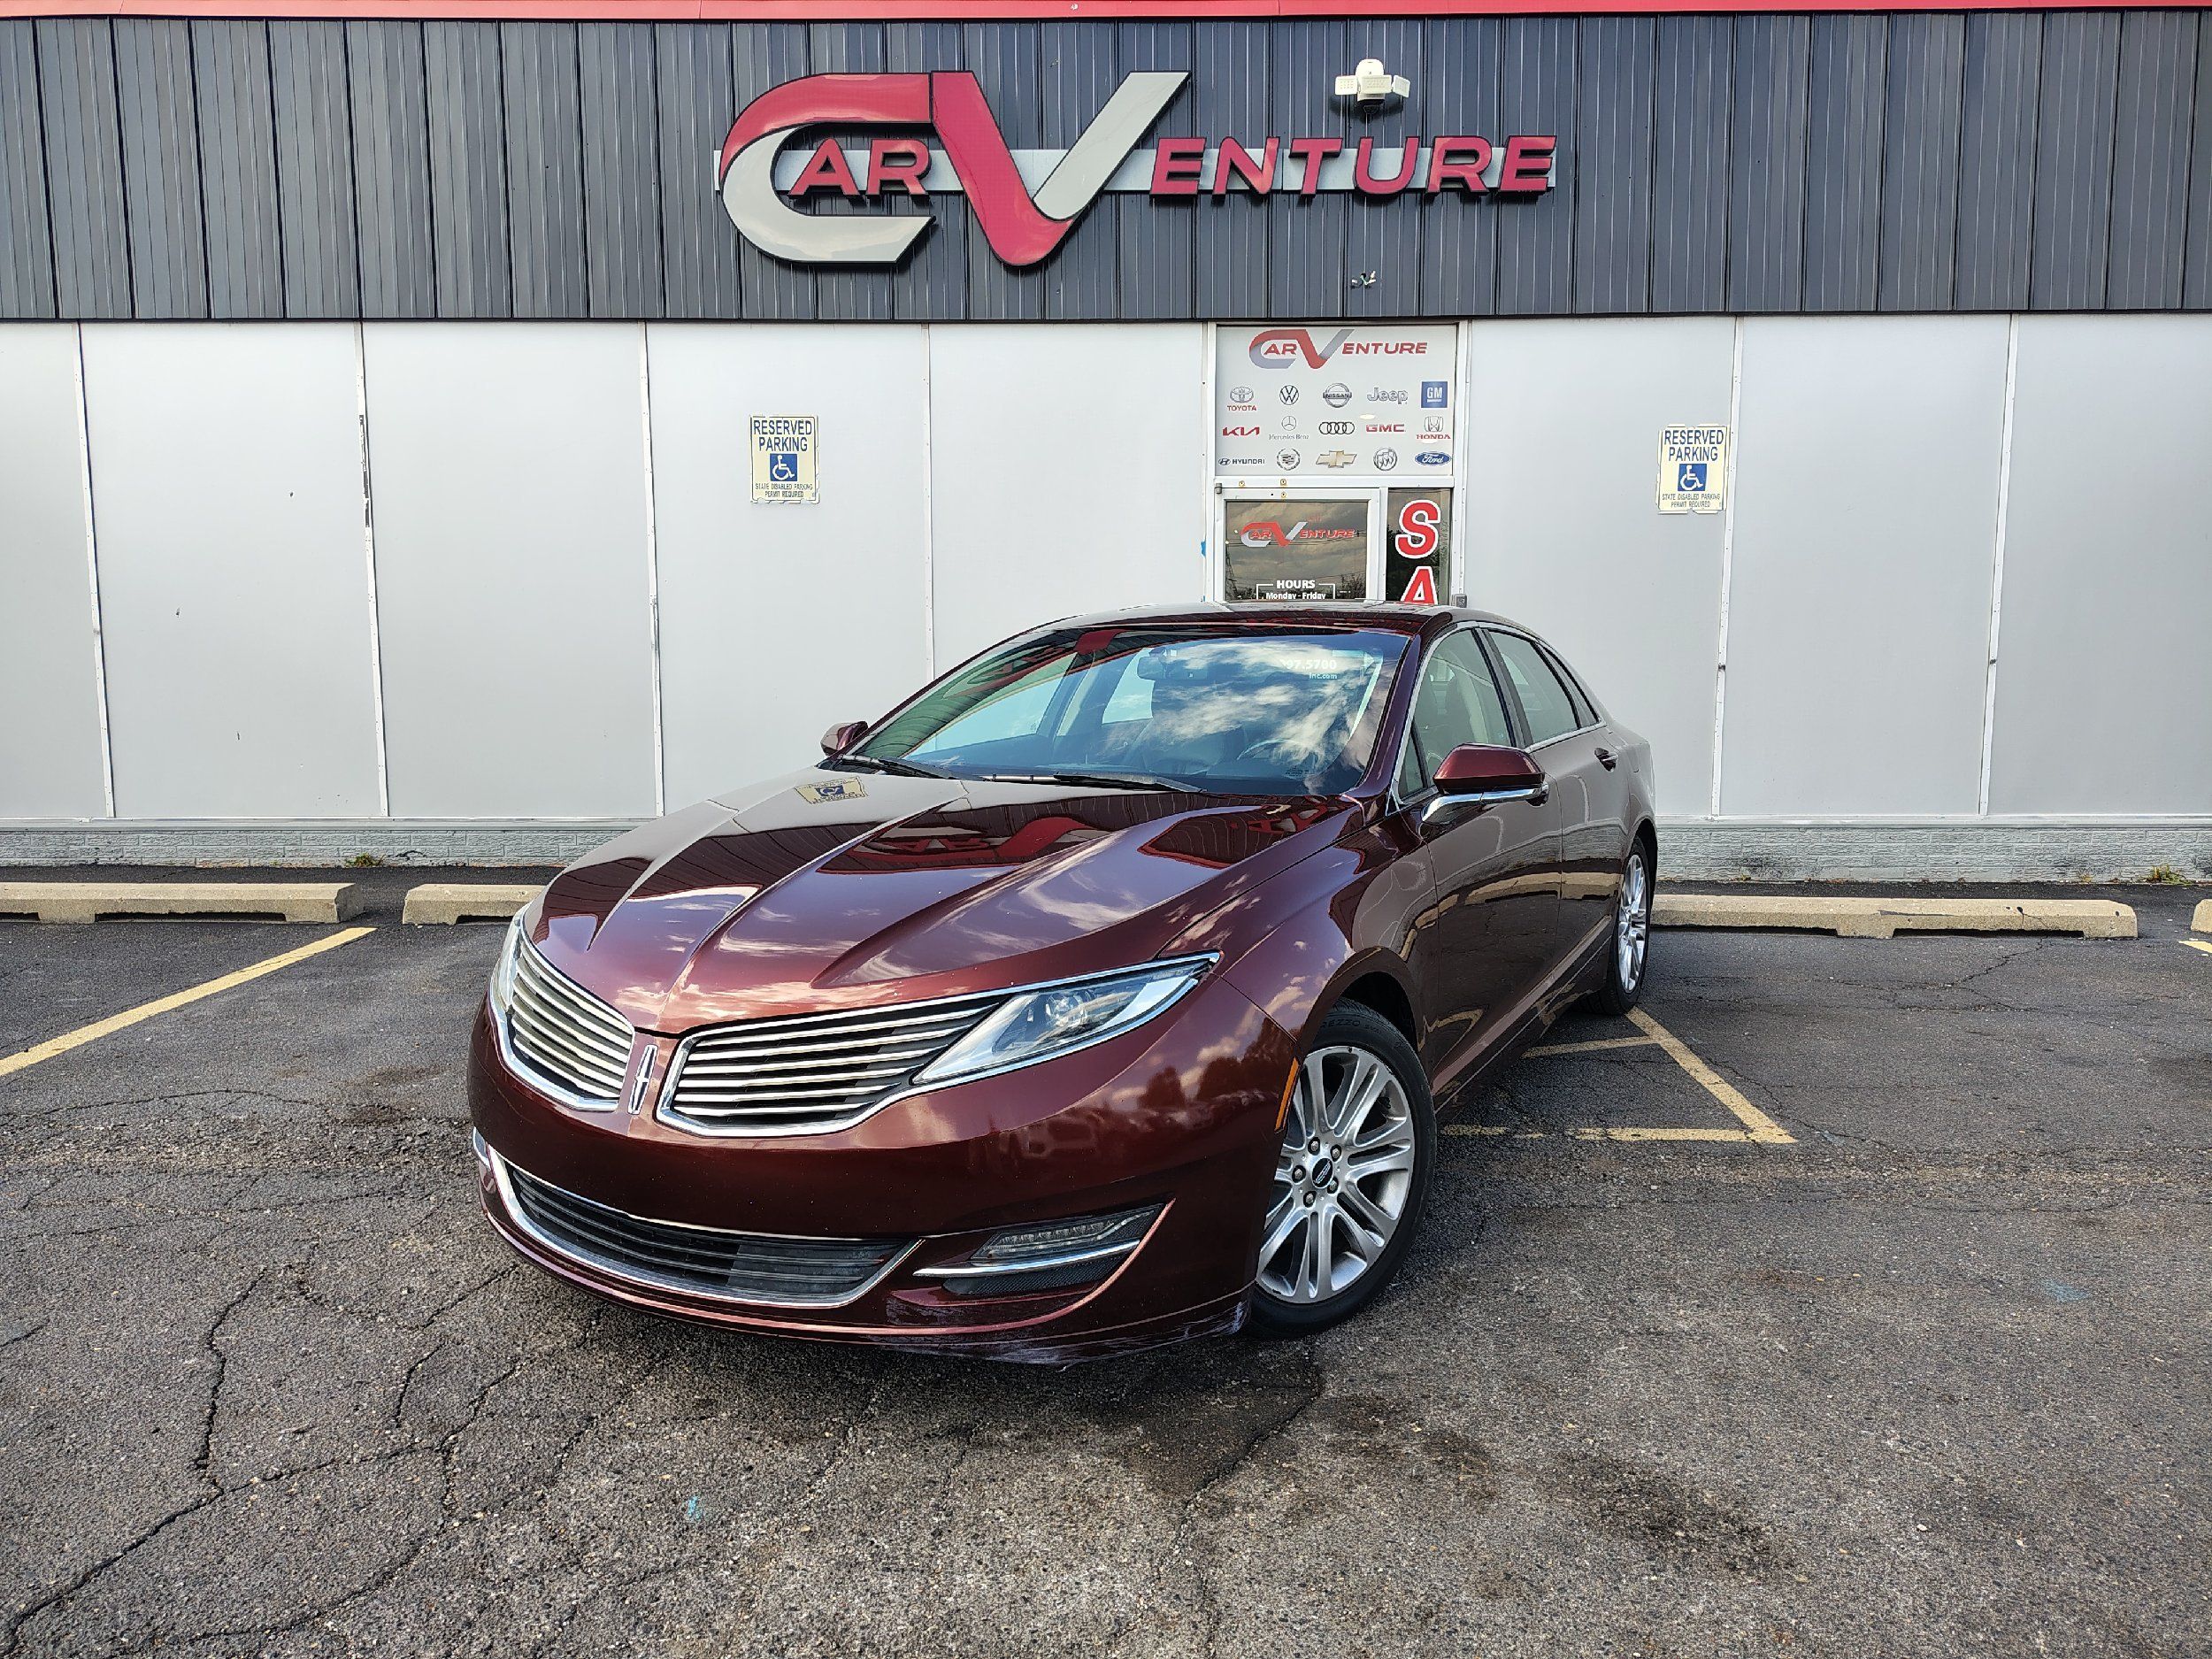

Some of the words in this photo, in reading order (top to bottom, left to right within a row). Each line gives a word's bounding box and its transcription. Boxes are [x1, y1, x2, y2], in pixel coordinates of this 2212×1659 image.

[1366, 387, 1409, 405] Jeep
[1426, 387, 1443, 399] GM
[753, 419, 812, 435] RESERVED
[1222, 426, 1260, 437] KIA
[1365, 423, 1405, 433] GMC
[758, 436, 808, 452] PARKING
[1664, 429, 1724, 445] RESERVED
[1421, 453, 1444, 464] Ford
[1668, 446, 1718, 462] PARKING
[1276, 580, 1316, 589] HOURS
